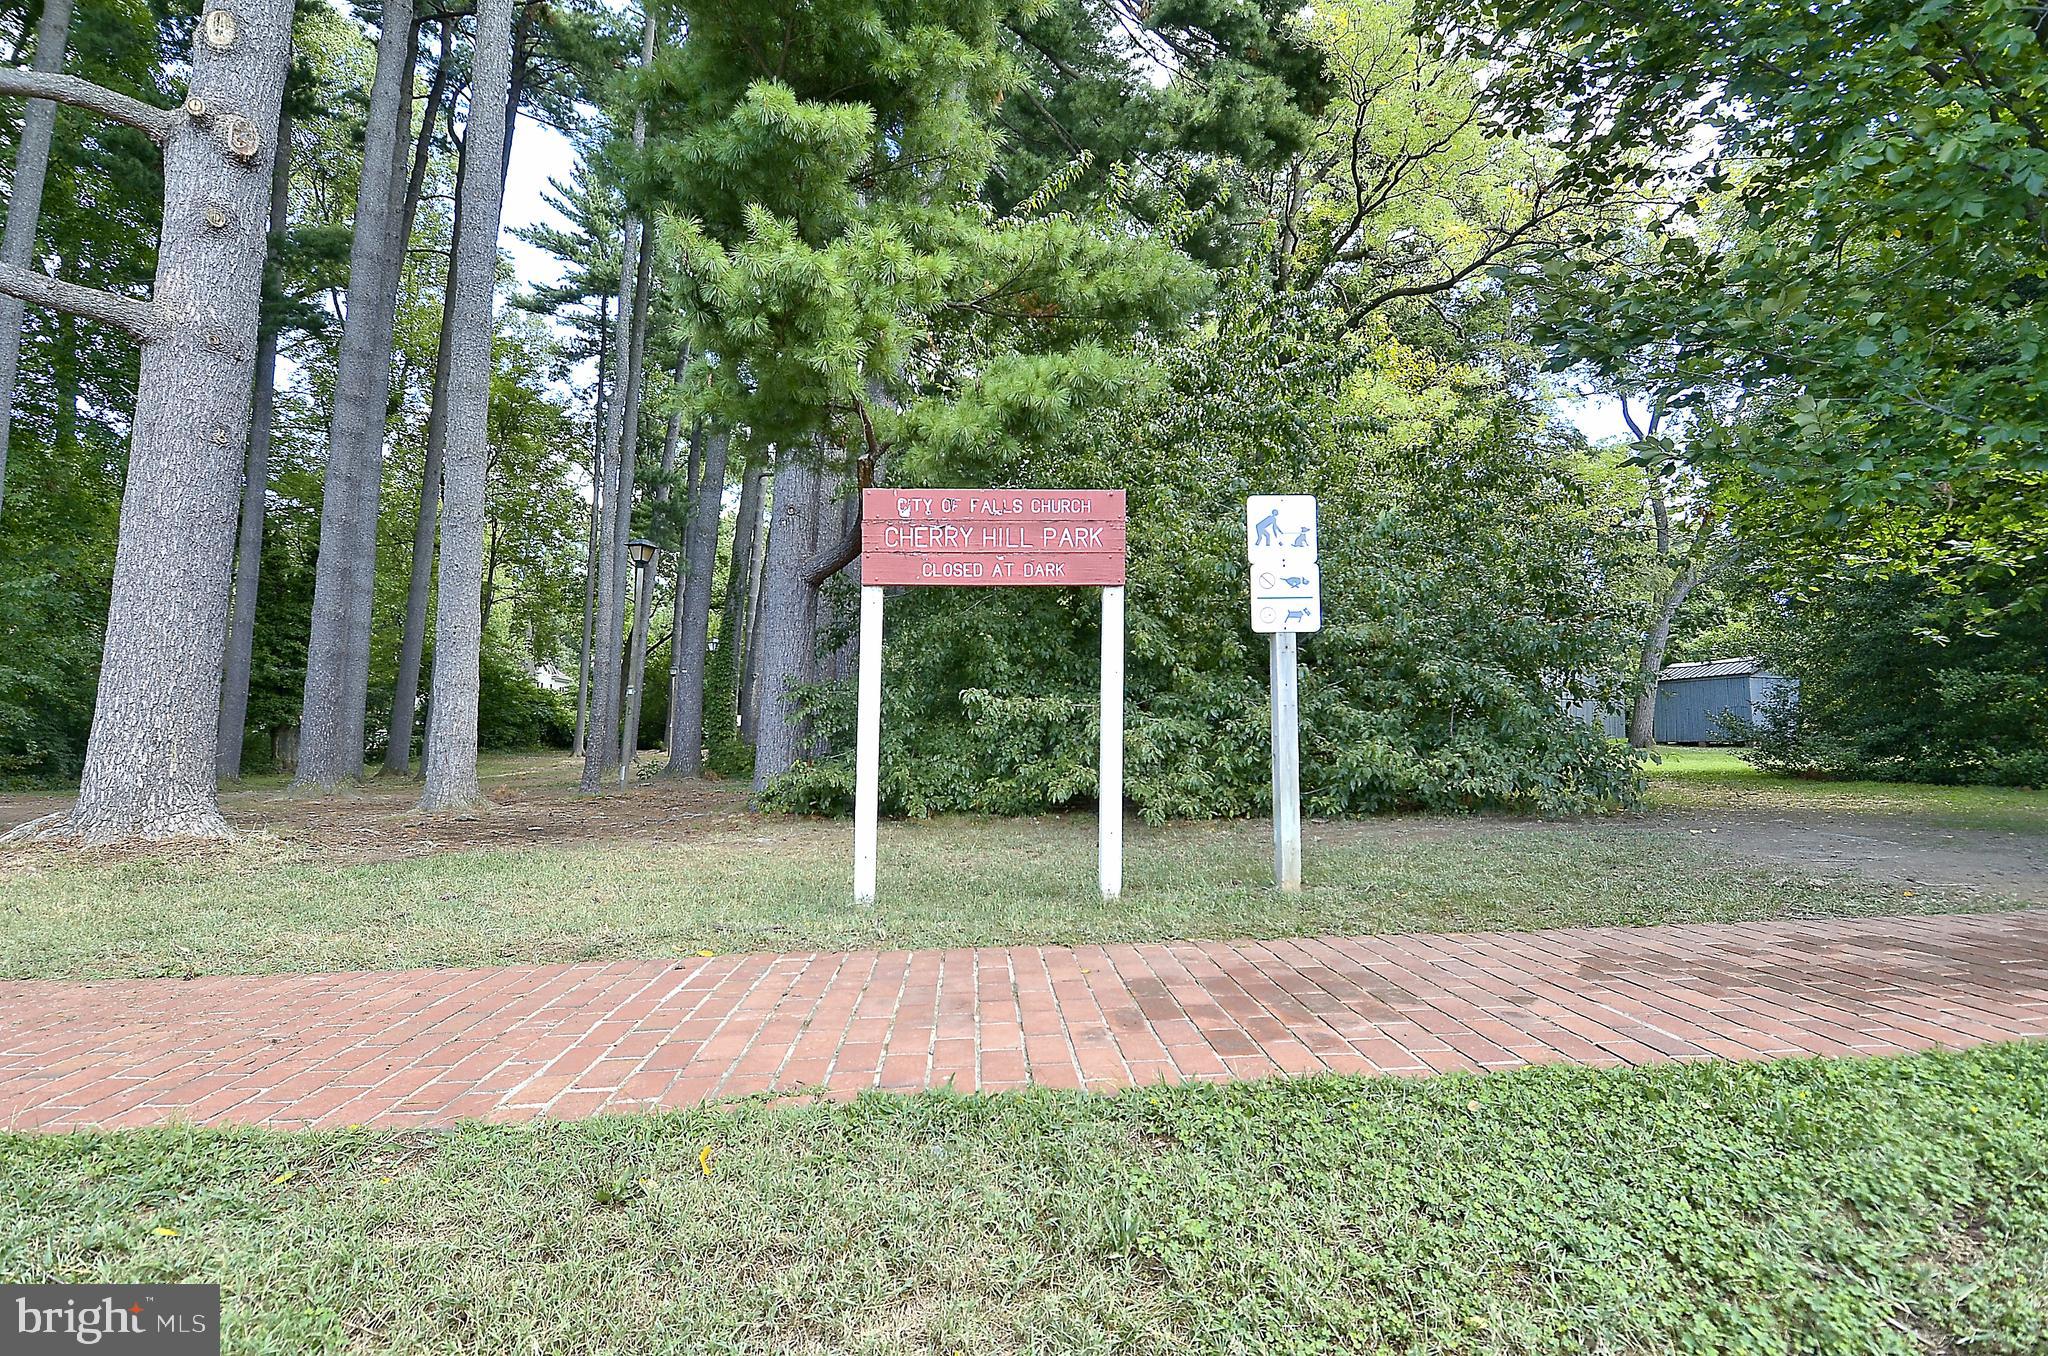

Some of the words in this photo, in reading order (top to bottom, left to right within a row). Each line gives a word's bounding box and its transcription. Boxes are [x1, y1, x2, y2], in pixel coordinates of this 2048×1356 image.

[970, 498, 1023, 515] FALLS
[1031, 498, 1092, 514] CHURCH
[884, 527, 974, 548] CHERRY
[982, 527, 1033, 548] HILL
[1043, 526, 1104, 548] PARK
[922, 562, 983, 578] CLOSED
[991, 562, 1015, 578] AT
[1023, 562, 1066, 578] DARK
